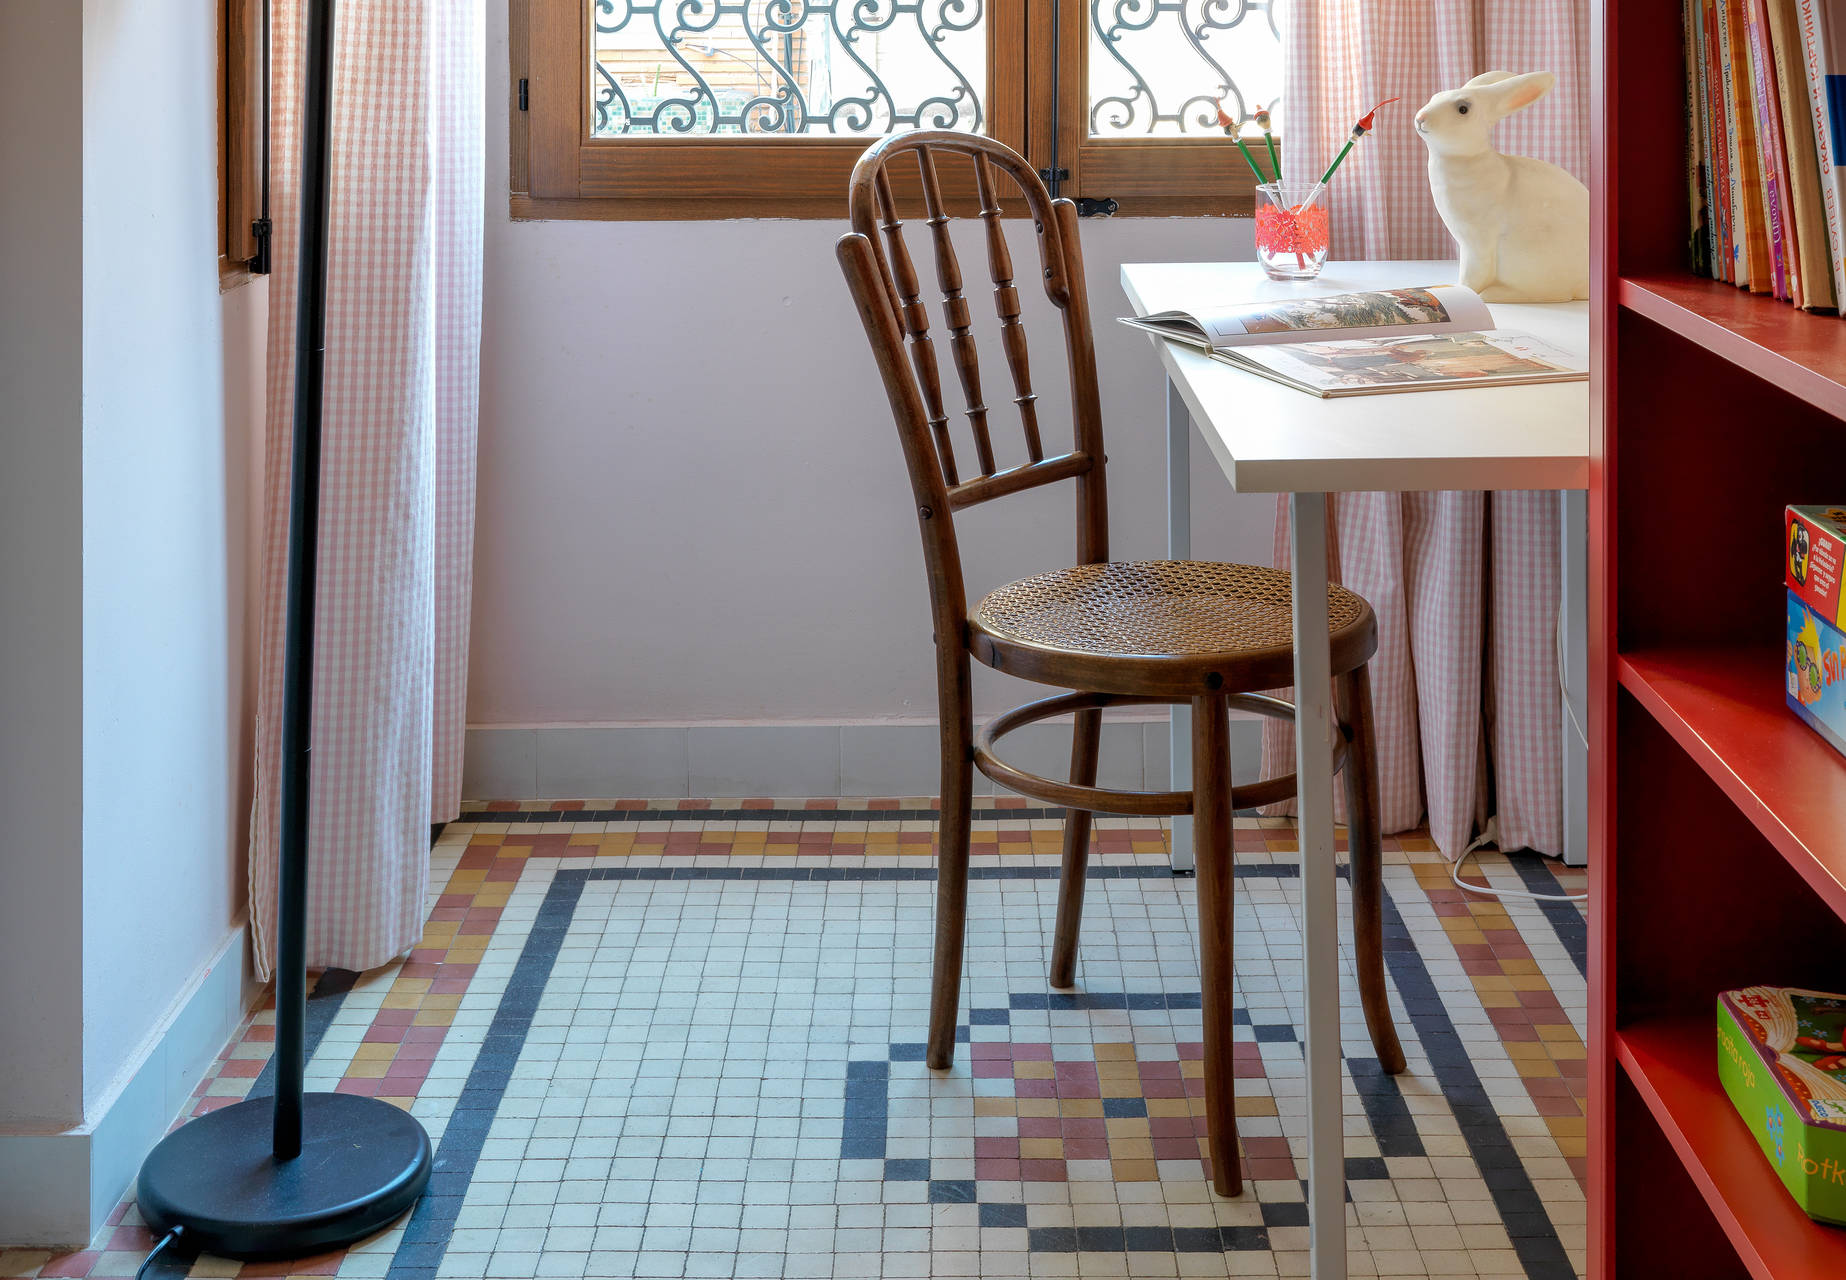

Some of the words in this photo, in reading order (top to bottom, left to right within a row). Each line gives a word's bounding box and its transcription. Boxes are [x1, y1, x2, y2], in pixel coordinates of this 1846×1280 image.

[1813, 87, 1822, 100] И
[1815, 104, 1829, 175] СКАЗКИ
[1825, 187, 1840, 252] СУТЕЕВ
